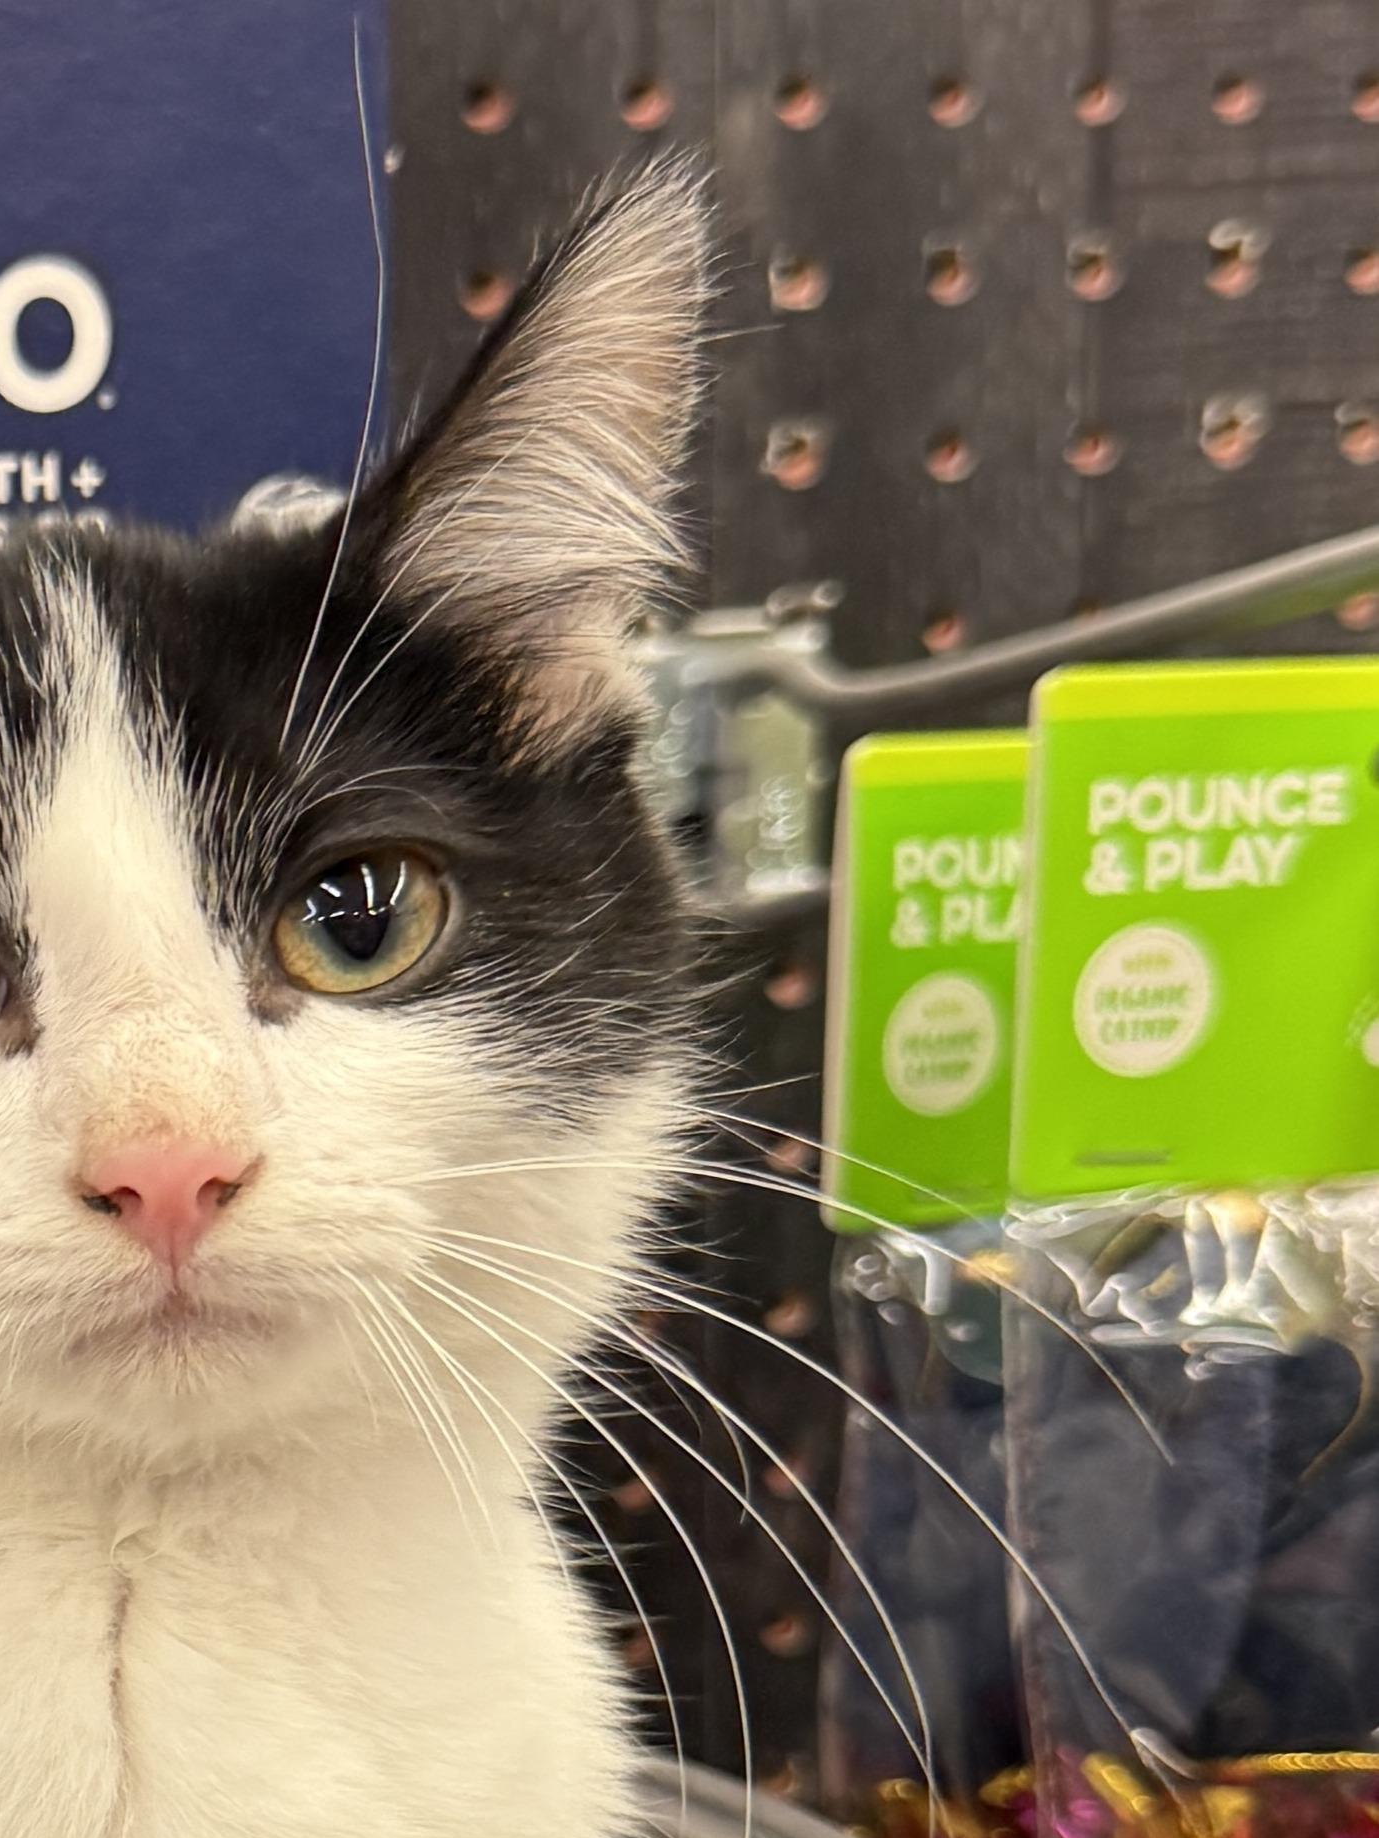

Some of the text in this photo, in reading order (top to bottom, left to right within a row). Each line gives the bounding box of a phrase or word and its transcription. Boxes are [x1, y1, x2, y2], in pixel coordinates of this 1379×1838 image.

[1090, 771, 1346, 834] POUNCE
[1086, 836, 1298, 893] & PLAY
[890, 896, 929, 948] &
